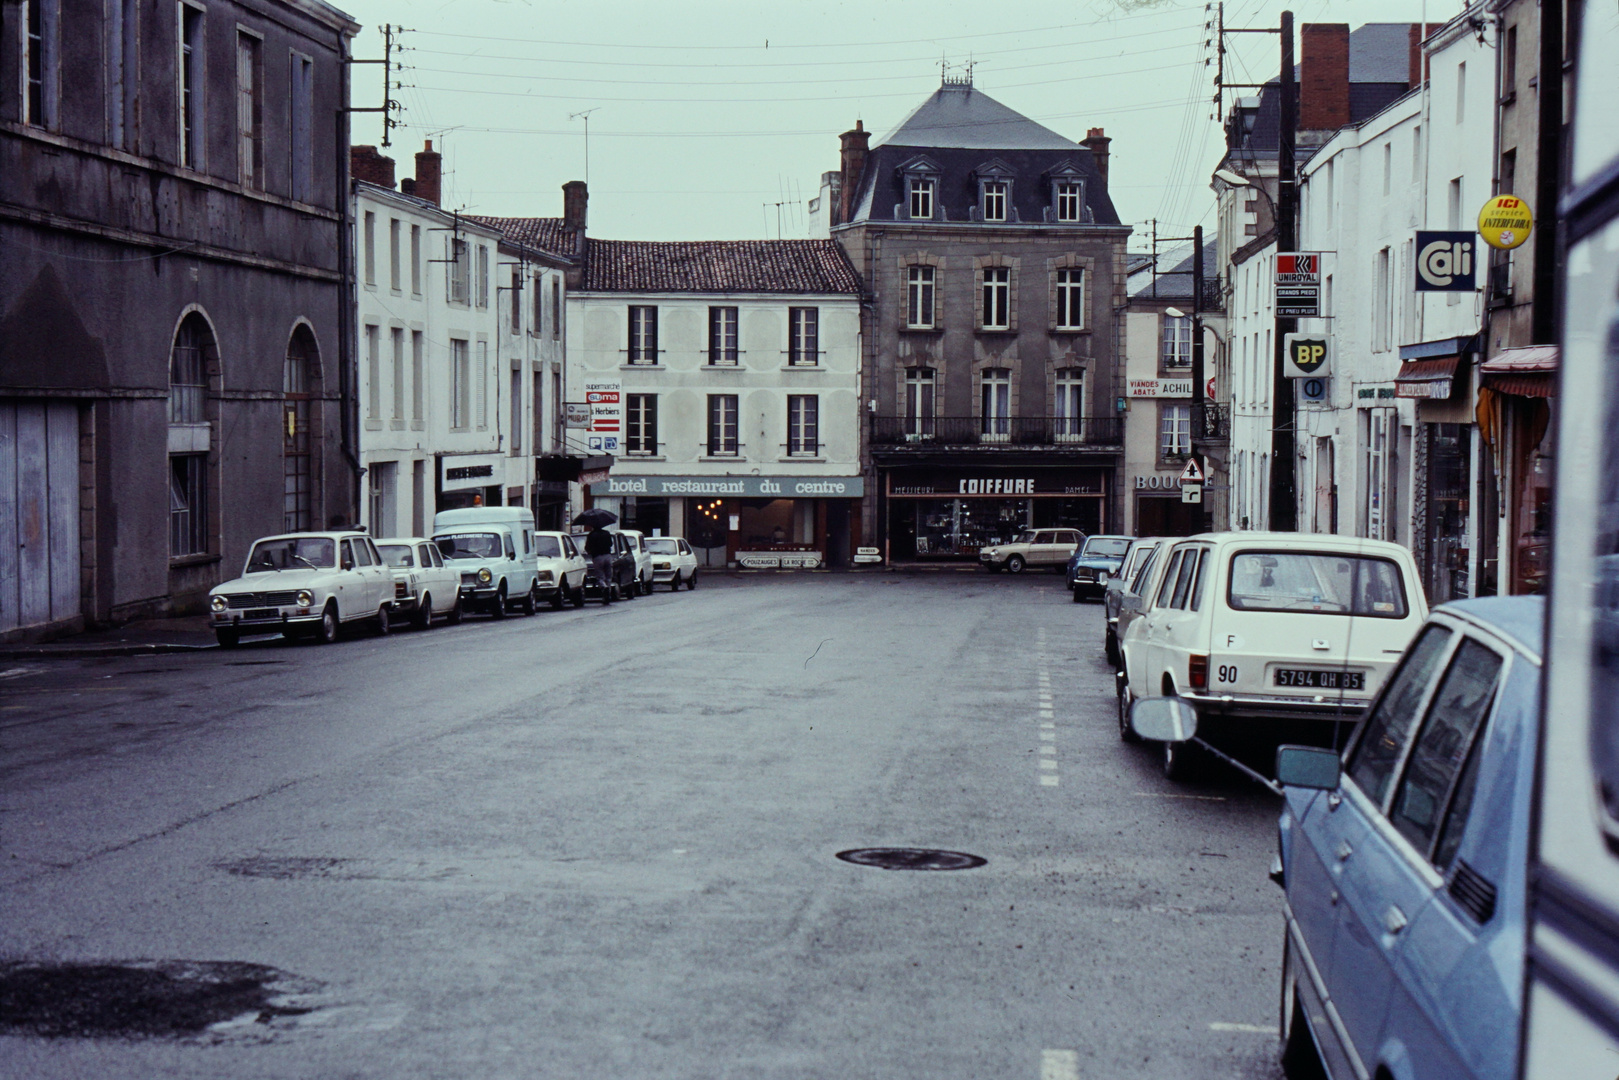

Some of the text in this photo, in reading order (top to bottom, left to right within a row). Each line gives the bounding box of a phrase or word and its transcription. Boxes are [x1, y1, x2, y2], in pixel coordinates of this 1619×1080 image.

[1497, 199, 1519, 208] ICI
[1482, 218, 1530, 229] INTERFLORA
[1418, 240, 1471, 287] Cali
[1278, 273, 1317, 282] UNIROYAL
[1297, 345, 1324, 364] BP
[586, 383, 620, 391] supermarché
[1162, 384, 1192, 394] ACHIL
[596, 407, 620, 415] Herbiers
[568, 414, 589, 423] MURAT
[608, 479, 845, 494] hotel restaurant du centre
[959, 479, 1035, 494] COIFFURE
[1227, 635, 1235, 648] F
[1218, 664, 1237, 683] 90
[1280, 671, 1359, 688] 5794 QH 85
